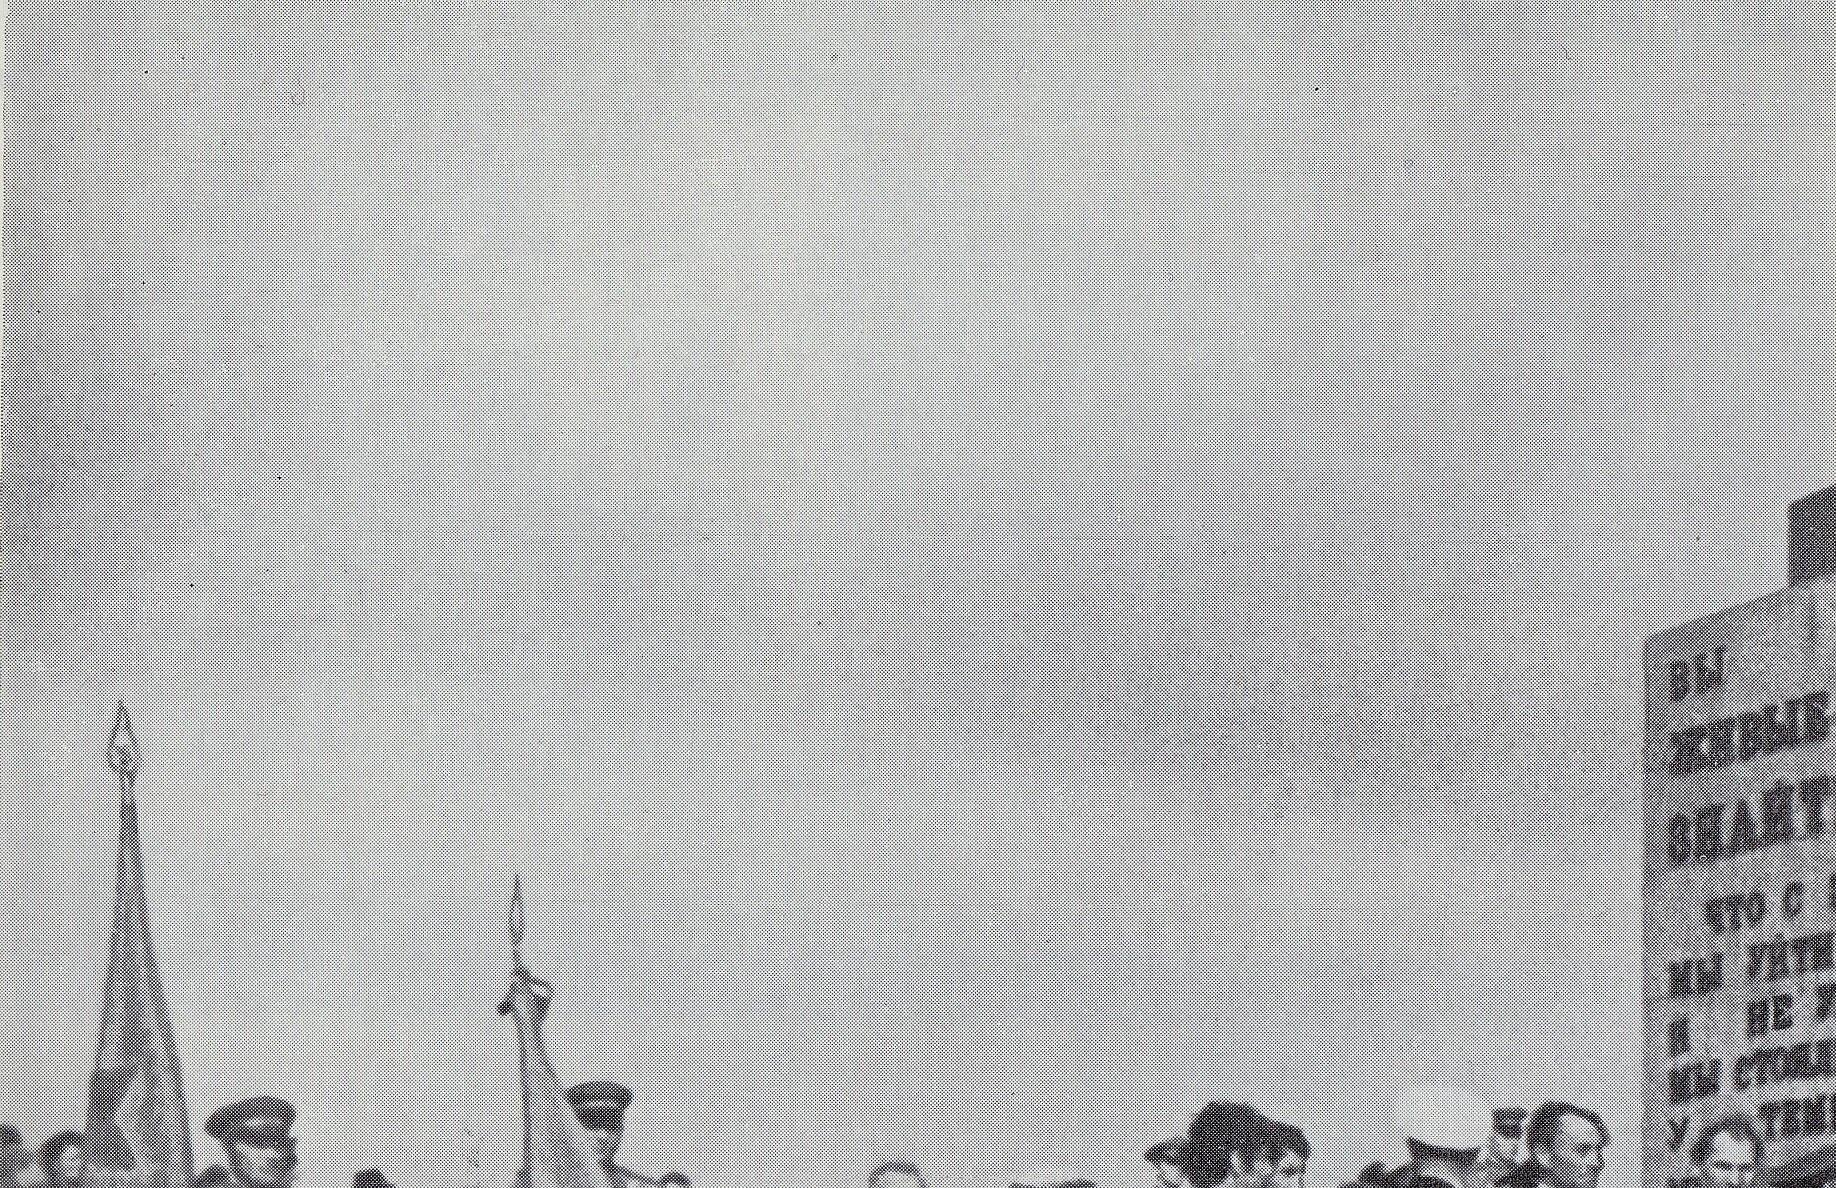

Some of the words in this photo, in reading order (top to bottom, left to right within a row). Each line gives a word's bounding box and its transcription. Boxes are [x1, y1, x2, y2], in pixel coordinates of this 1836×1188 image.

[1670, 645, 1726, 702] ВЫ
[1669, 689, 1830, 776] ЖИВЫЕ
[1706, 890, 1765, 933] ЧТО
[1784, 881, 1804, 919] С
[1668, 953, 1722, 997] МЫ
[1747, 931, 1835, 981] УЙТИ
[1668, 1014, 1690, 1058] И
[1747, 994, 1793, 1038] НЕ
[1668, 1058, 1721, 1104] МЫ
[1667, 1116, 1689, 1153] У
